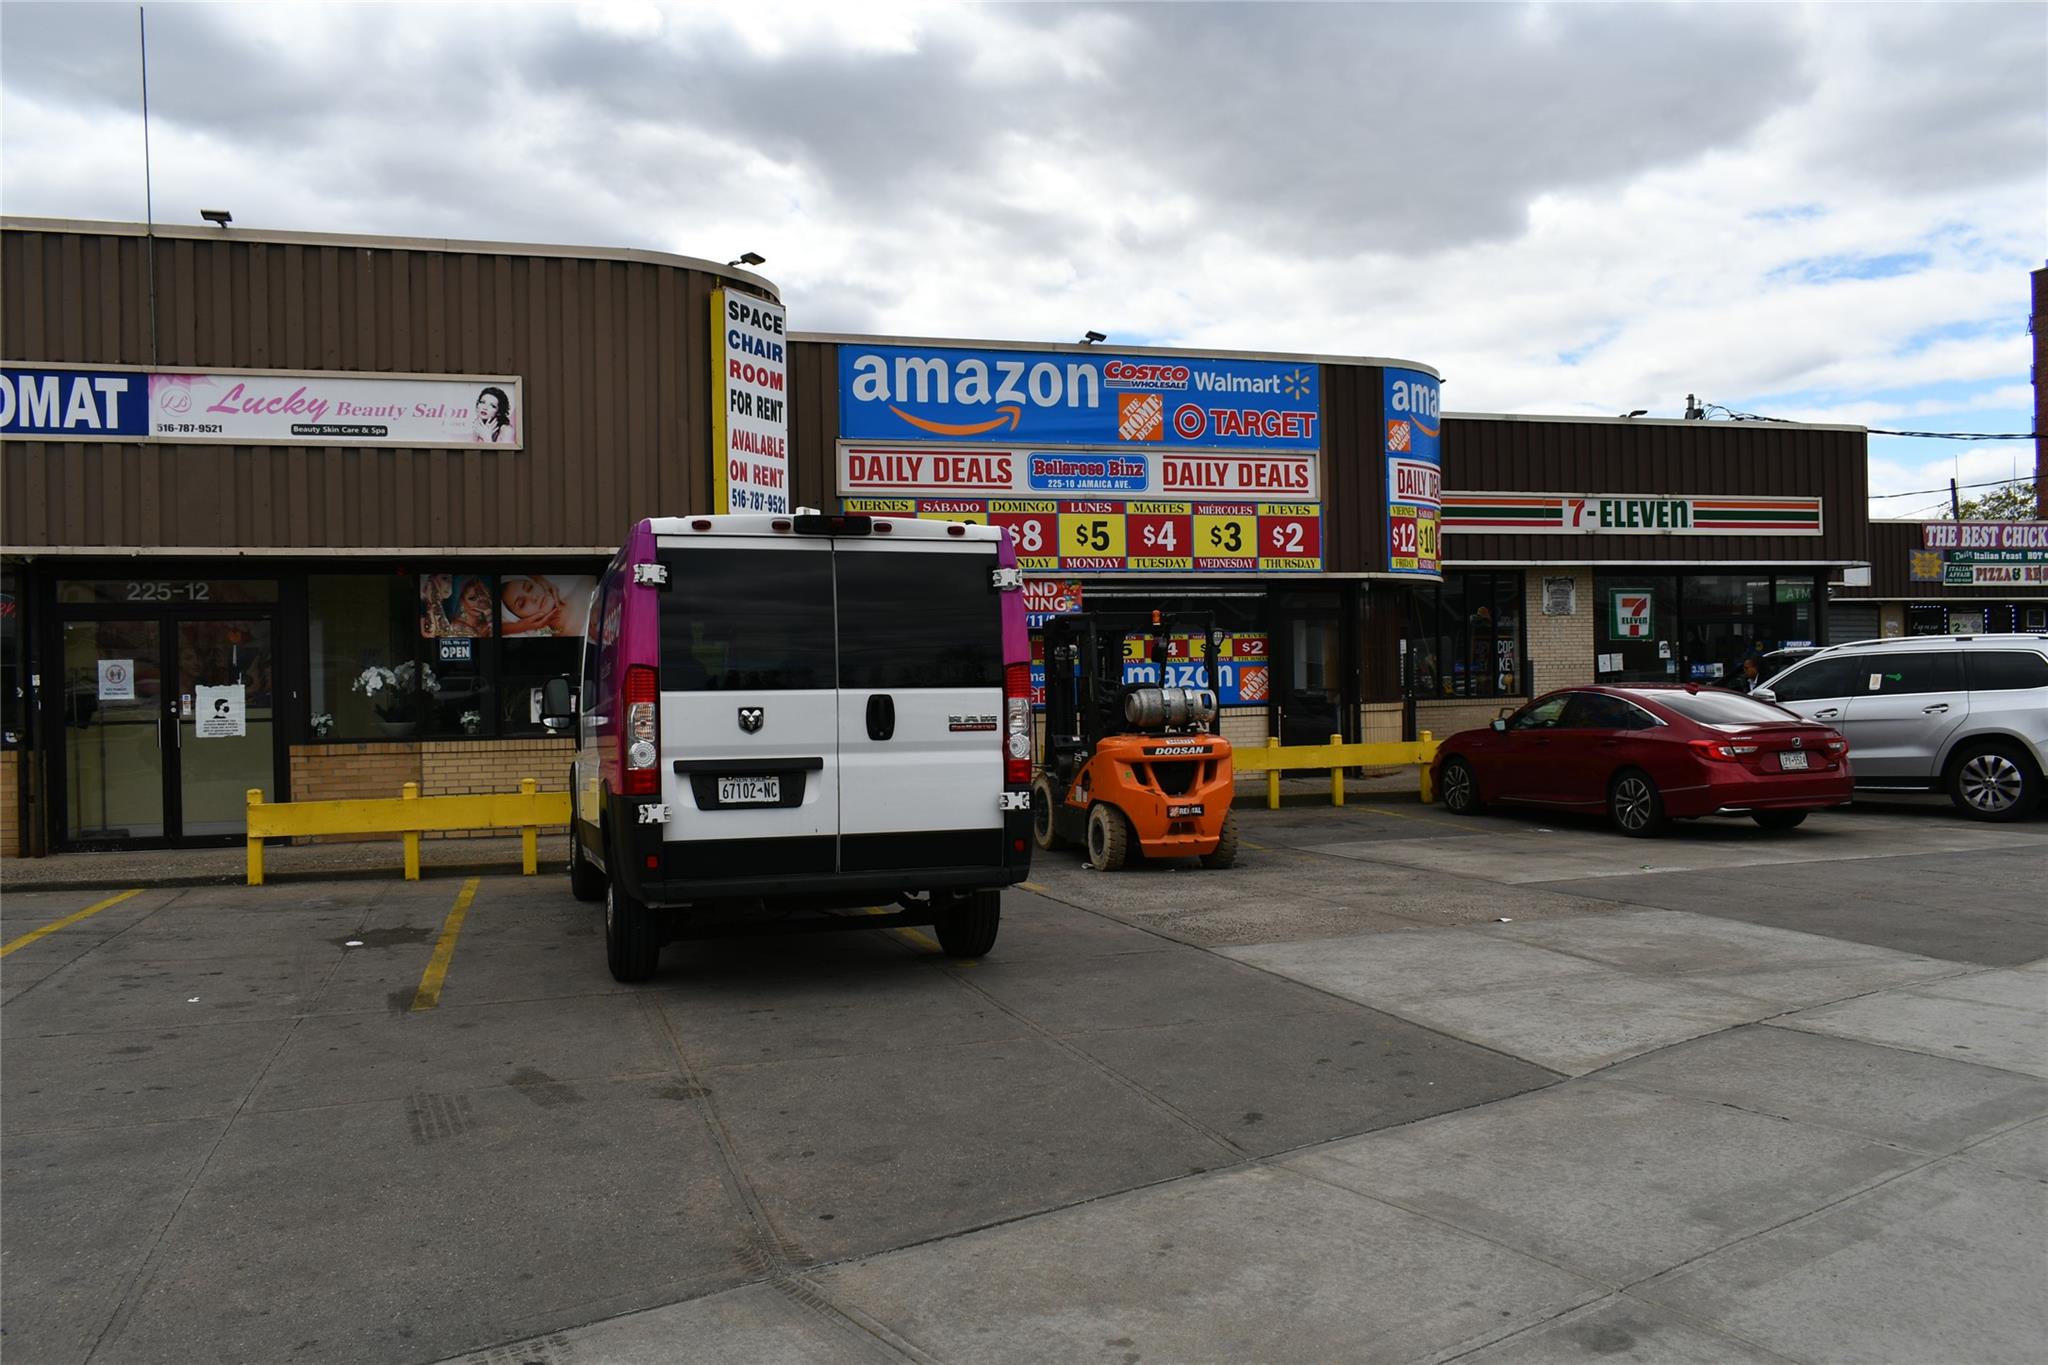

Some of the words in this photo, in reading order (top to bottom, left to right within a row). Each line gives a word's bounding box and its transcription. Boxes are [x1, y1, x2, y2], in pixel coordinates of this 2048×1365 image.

[728, 300, 783, 335] SPACE
[728, 330, 783, 363] CHAIR
[729, 359, 783, 391] ROOM
[852, 354, 1099, 408] amazon
[1104, 361, 1189, 382] COSTCO
[1131, 380, 1187, 389] WHOLESALE
[1194, 371, 1281, 394] Walmart
[206, 383, 329, 422] Lucky
[336, 401, 407, 421] Beauty
[731, 389, 752, 416] FOR
[757, 396, 783, 423] RENT
[1122, 398, 1142, 417] THE
[1391, 380, 1440, 418] ama
[1118, 394, 1163, 440] HOME
[1136, 411, 1163, 441] DEPOT
[1209, 410, 1317, 438] TARGET
[157, 424, 222, 433] 516-787-9521
[293, 425, 320, 435] Beauty
[323, 425, 340, 434] Skin
[342, 426, 359, 434] Care
[362, 426, 369, 434] &
[371, 426, 386, 435] Spa
[731, 429, 785, 459] AVAILABLE
[730, 460, 748, 482] ON
[753, 465, 784, 489] RENT
[849, 456, 922, 482] DAILY
[934, 458, 1012, 483] DEALS
[1033, 459, 1104, 476] Bellerose
[1108, 459, 1144, 476] Binz
[1163, 461, 1228, 487] DAILY
[1238, 464, 1309, 488] DEALS
[1048, 480, 1075, 488] 225-10
[1077, 480, 1112, 488] JAMAICA
[1114, 480, 1132, 488] AVE.
[1397, 468, 1427, 495] DAILY
[732, 489, 786, 514] 516-787-9521
[850, 501, 909, 511] VIERNES
[923, 501, 980, 512] SÁBADO
[992, 502, 1055, 512] DOMINGO
[1071, 502, 1112, 512] LUNES
[1133, 503, 1184, 513] MARTES
[1198, 504, 1252, 515] MIÉRCOLES
[1266, 505, 1310, 515] JUEVES
[1392, 506, 1415, 516] VIERNES
[1008, 519, 1043, 552] $8
[1076, 521, 1110, 551] $5
[1143, 521, 1176, 551] $4
[1210, 522, 1242, 552] $3
[1272, 523, 1304, 552] $2
[1392, 523, 1415, 553] $12
[1419, 526, 1434, 554] $10
[1925, 526, 1957, 547] THE
[1961, 526, 1998, 547] BEST
[1016, 558, 1051, 568] NDAY
[1066, 559, 1120, 569] MONDAY
[1134, 558, 1188, 569] TUESDAY
[1199, 559, 1254, 569] WEDNESDAY
[1266, 559, 1317, 569] THURSDAY
[2027, 552, 2043, 560] HOT
[1975, 567, 2011, 581] PIZZA
[127, 583, 209, 600] 225-12
[1786, 588, 1811, 600] ATM
[441, 646, 470, 658] OPEN
[1242, 640, 1264, 655] $2
[1122, 664, 1232, 690] mazon
[1155, 747, 1203, 756] DOOSAN
